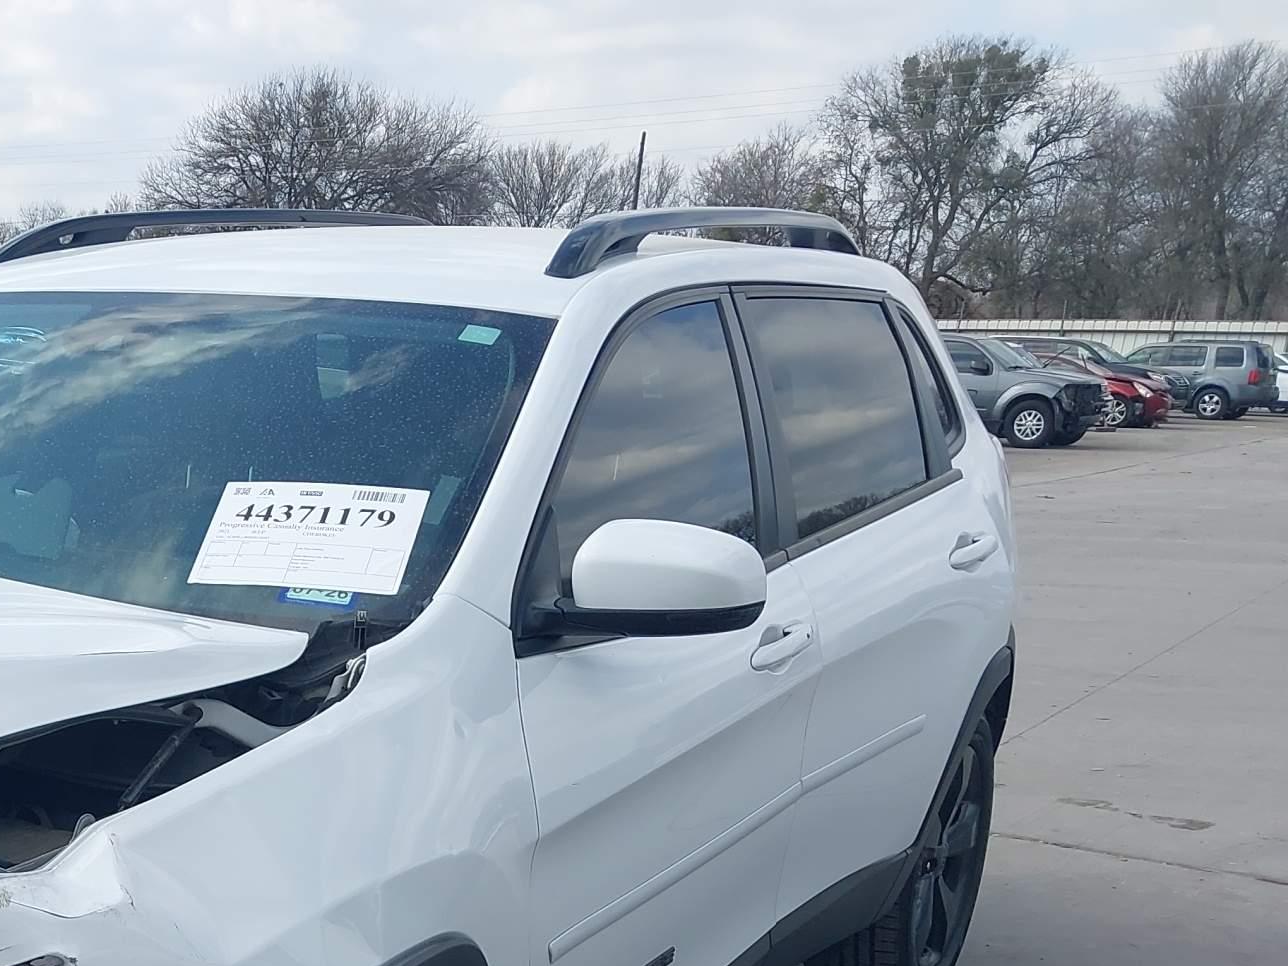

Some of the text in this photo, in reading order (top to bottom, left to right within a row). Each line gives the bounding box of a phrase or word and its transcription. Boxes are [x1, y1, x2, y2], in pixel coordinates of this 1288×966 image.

[235, 503, 396, 528] 44371179
[219, 521, 266, 529] Progressive
[304, 524, 345, 532] Insurance
